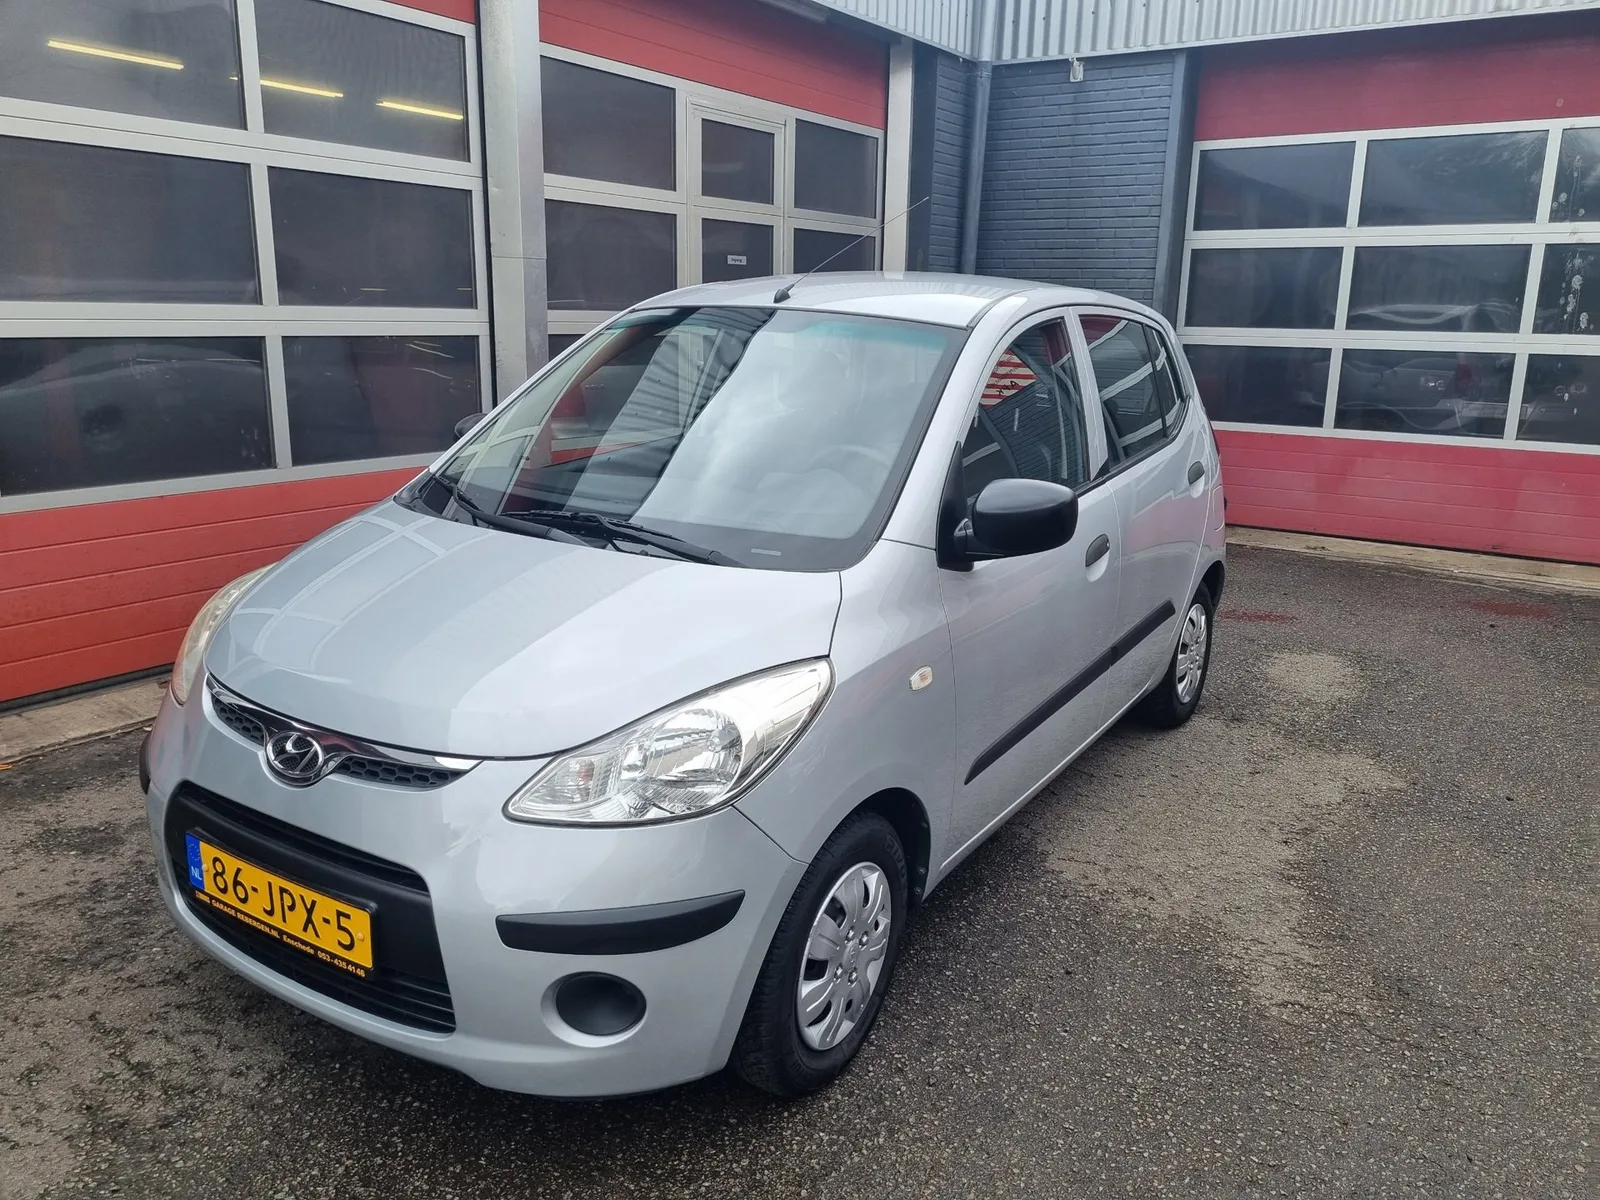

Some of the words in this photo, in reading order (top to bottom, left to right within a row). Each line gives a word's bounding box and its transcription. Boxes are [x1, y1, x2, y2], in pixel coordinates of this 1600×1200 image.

[191, 865, 203, 881] NL
[211, 899, 236, 917] GARAGE
[283, 934, 315, 955] Enschede
[212, 856, 355, 951] 86-JPX-5
